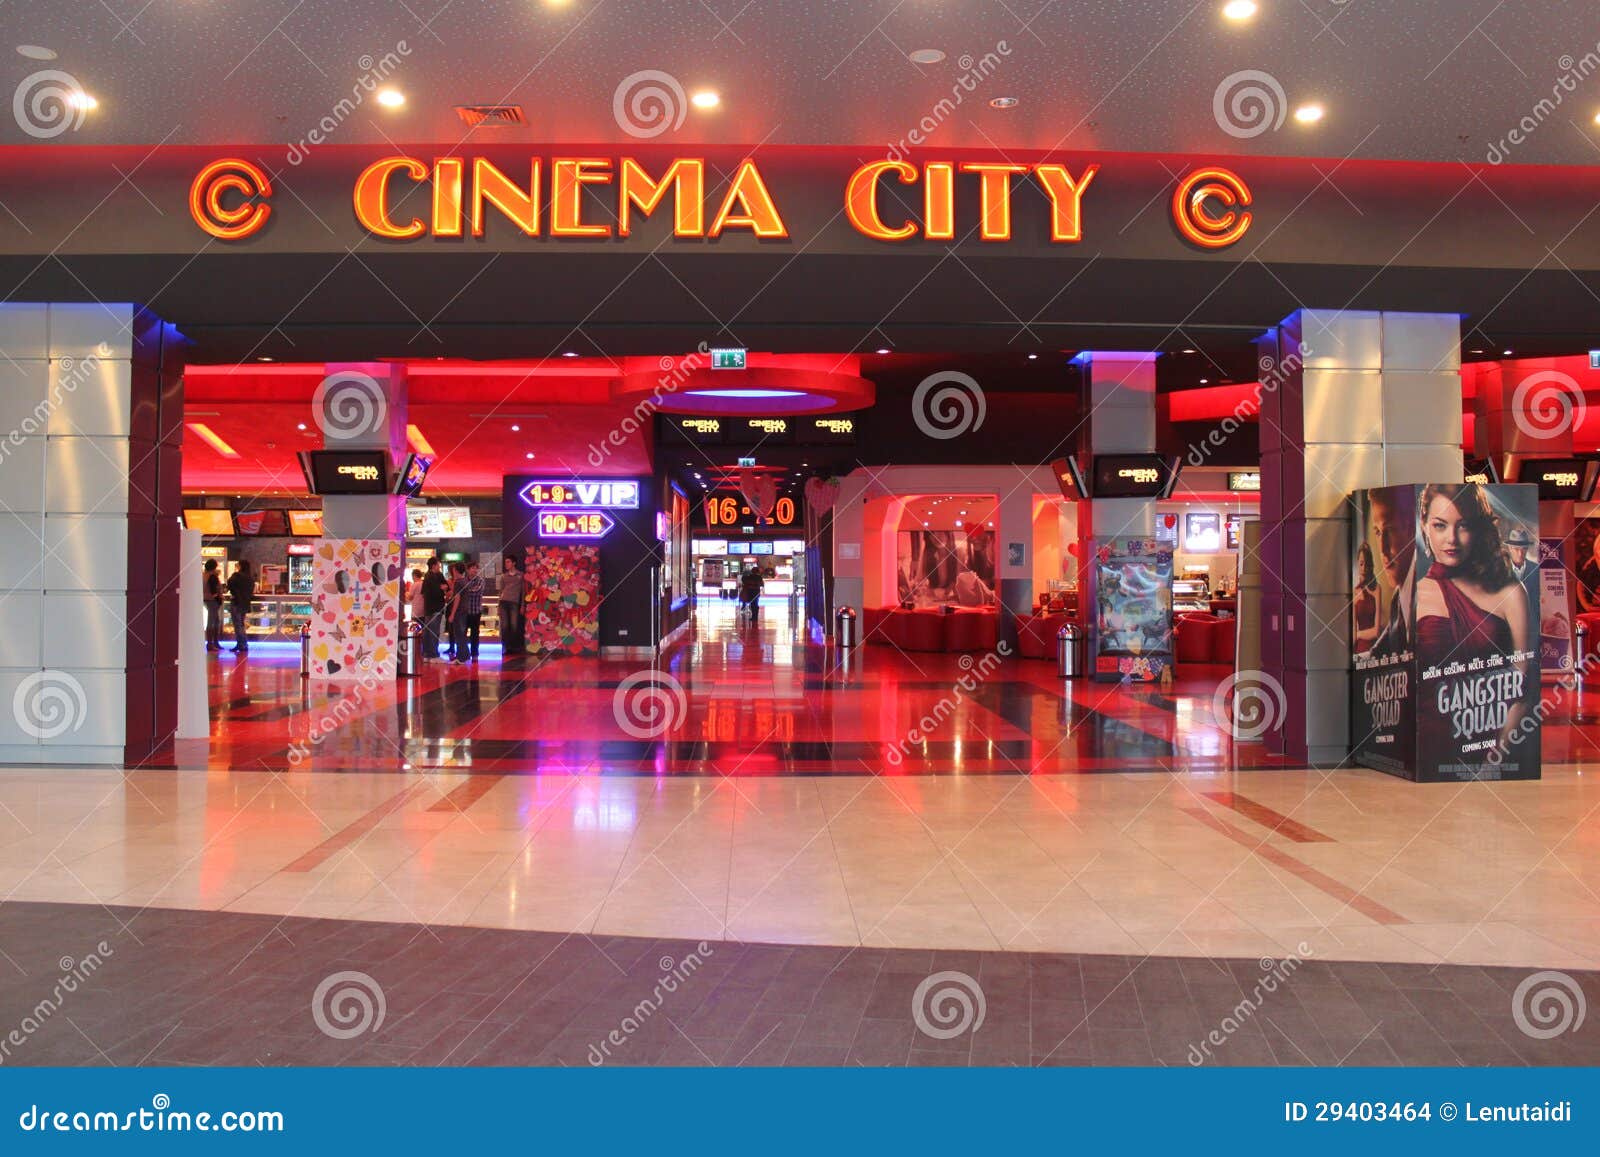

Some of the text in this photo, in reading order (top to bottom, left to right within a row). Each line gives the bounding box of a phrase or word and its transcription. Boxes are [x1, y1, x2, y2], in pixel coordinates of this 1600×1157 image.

[353, 156, 789, 238] CINEMA
[845, 160, 1098, 242] CITY
[682, 420, 719, 428] CINEMA
[749, 420, 786, 428] CINEMA
[816, 420, 853, 428] CINEMA
[338, 466, 378, 474] CINEMA
[1119, 469, 1158, 478] CINEMA
[354, 472, 378, 480] CITY
[1543, 473, 1578, 481] CINEMA
[1364, 671, 1408, 704] GANGSTER
[1438, 671, 1523, 714] GANGSTER
[1371, 700, 1400, 732] SQUAD
[1452, 701, 1508, 740] SQUAD
[1462, 739, 1496, 753] COMING SOON
